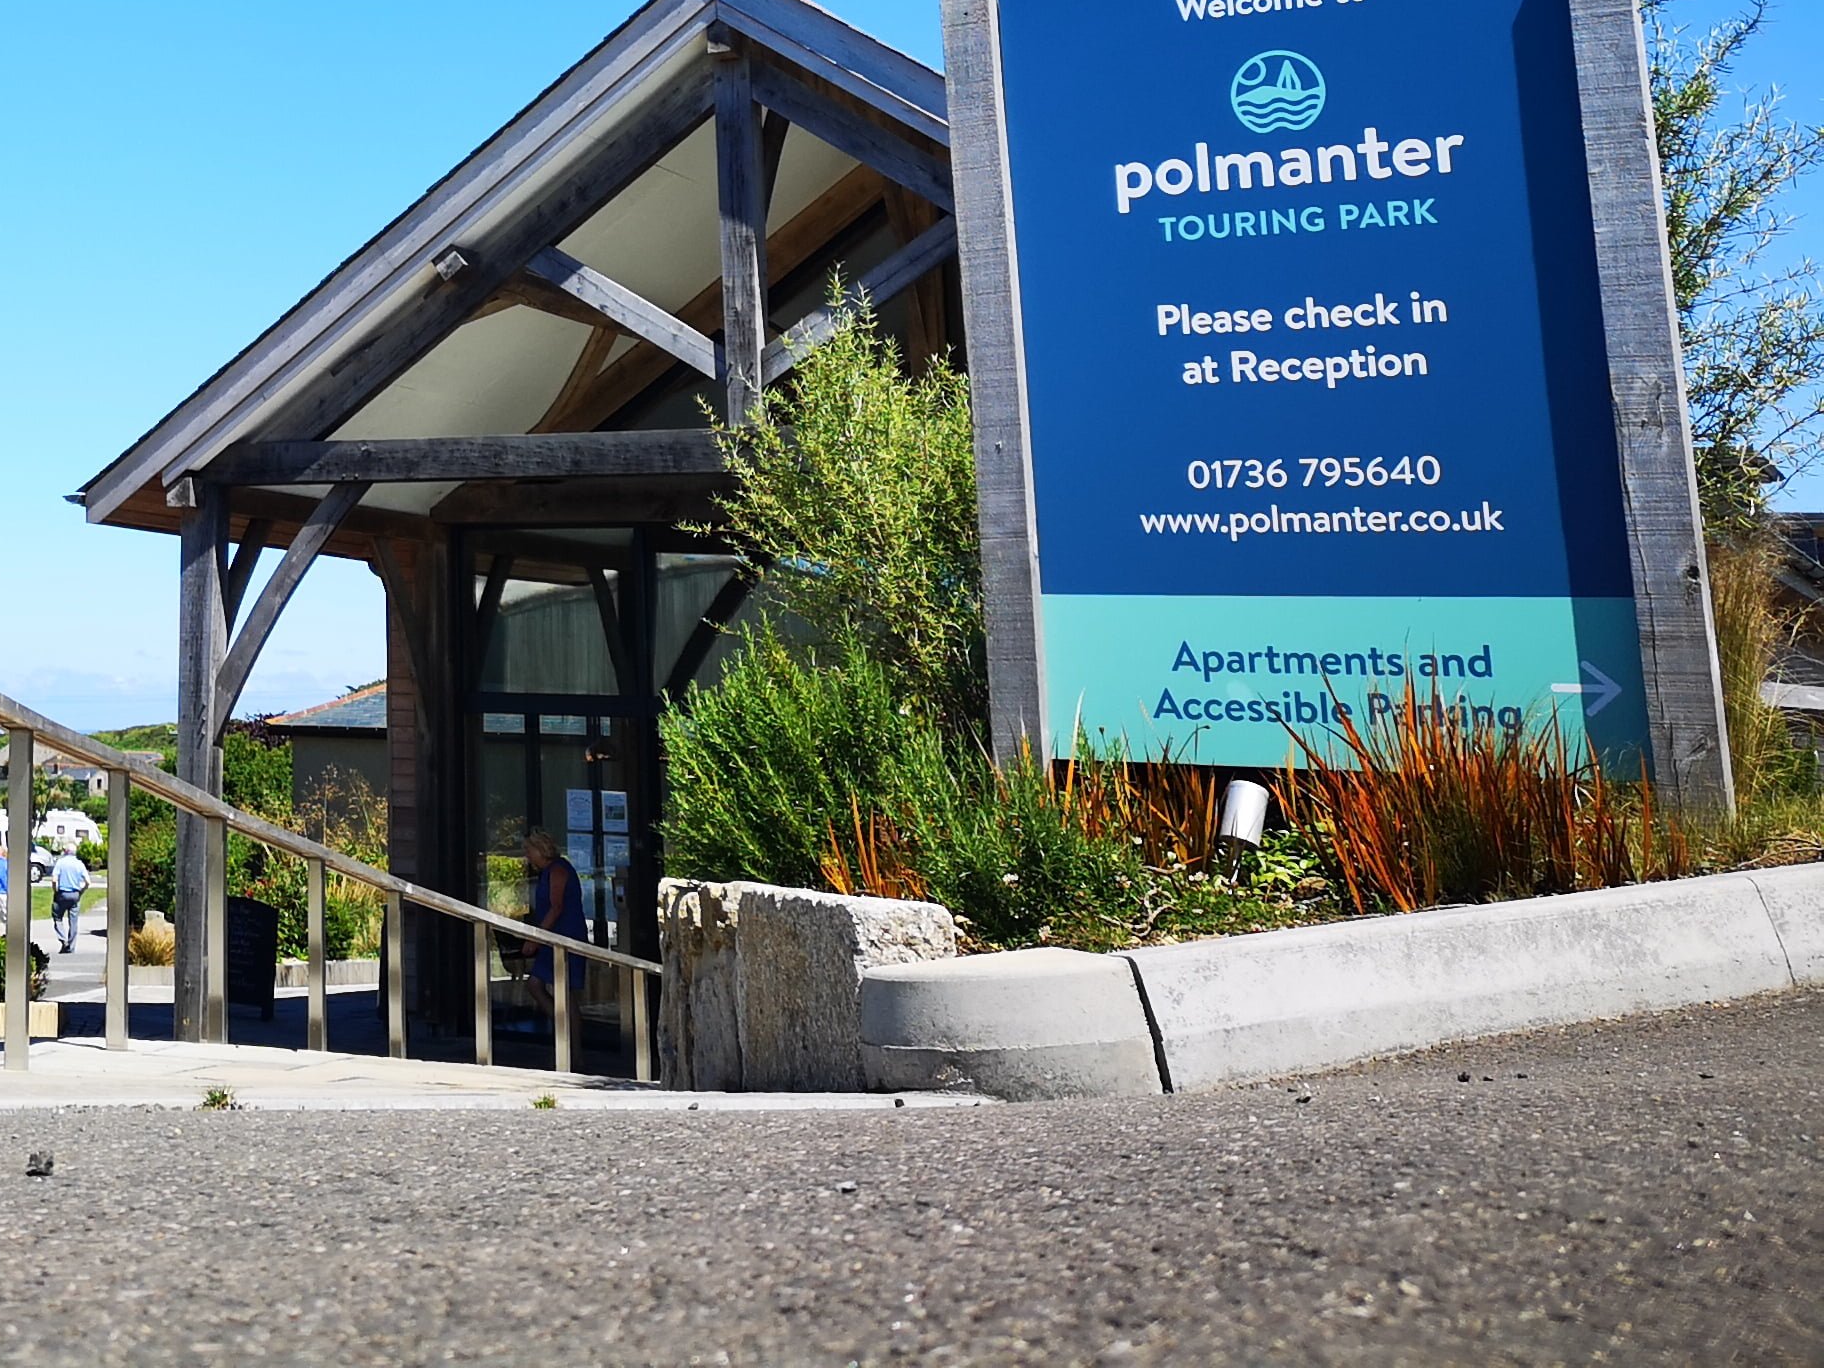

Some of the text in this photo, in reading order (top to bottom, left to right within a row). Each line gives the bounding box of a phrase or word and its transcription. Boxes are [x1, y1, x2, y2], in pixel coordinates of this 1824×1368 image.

[1114, 127, 1464, 214] polmanter
[1158, 198, 1438, 242] TOURING PARK
[1156, 291, 1448, 336] Please check in
[1182, 345, 1428, 389] at Reception
[1187, 455, 1441, 489] 01736 795640
[1139, 501, 1505, 542] www.polmanter.co.uk
[1171, 640, 1493, 683] Apartments and
[1153, 687, 1353, 726] Accessible
